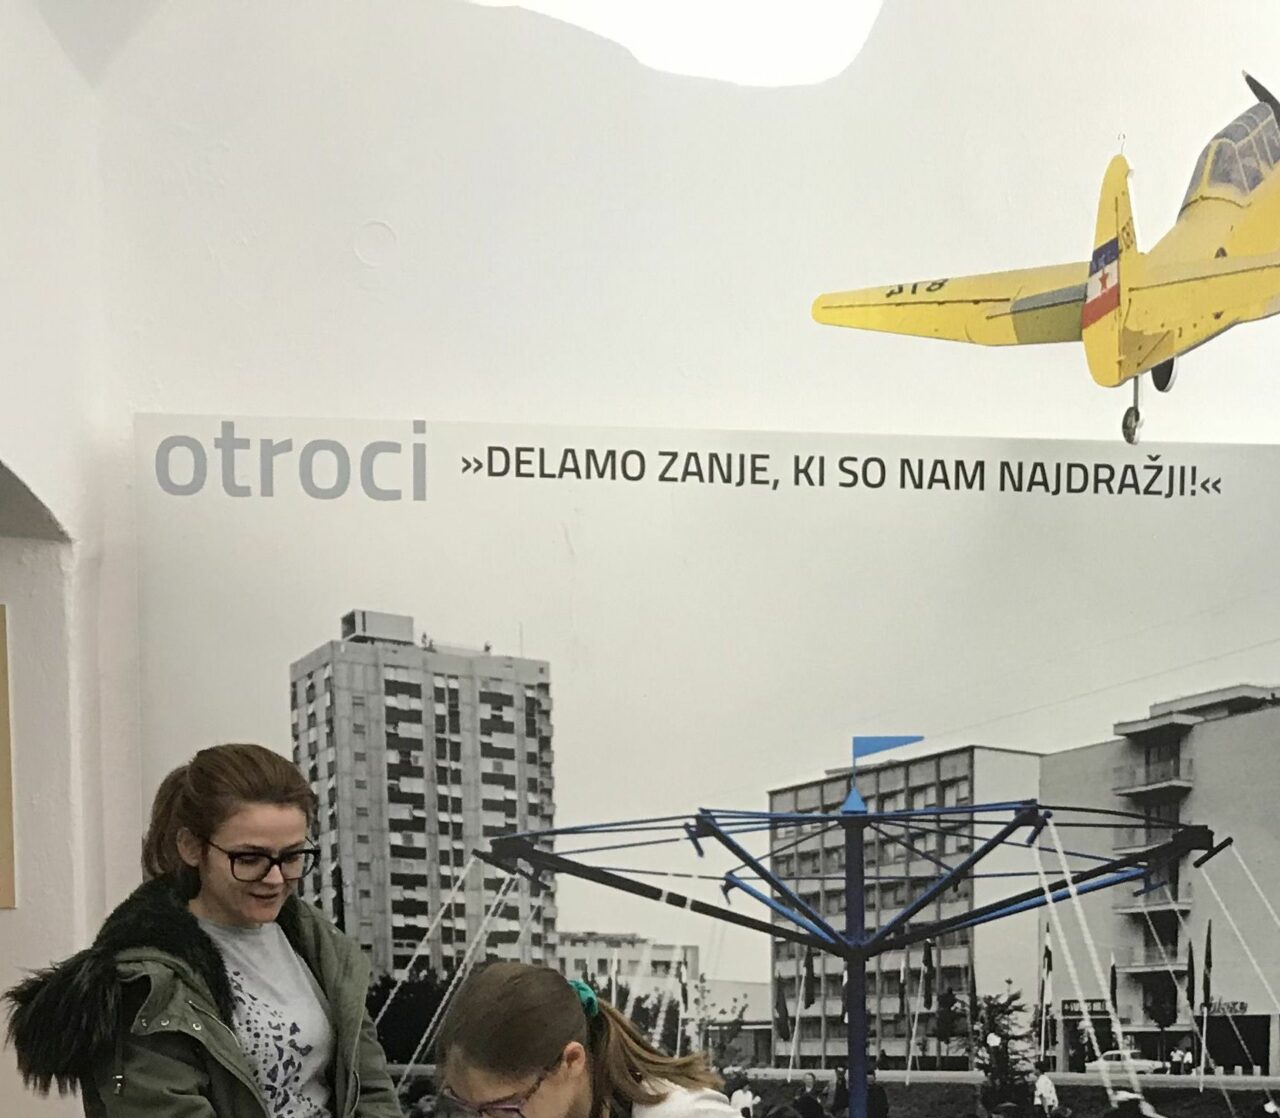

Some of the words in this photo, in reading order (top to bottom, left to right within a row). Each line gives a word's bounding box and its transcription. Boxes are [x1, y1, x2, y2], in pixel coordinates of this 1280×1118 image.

[154, 419, 428, 502] otroci
[656, 450, 780, 491] ZANJE,
[792, 454, 826, 487] KI
[837, 456, 887, 489] SO
[898, 458, 986, 492] NAM
